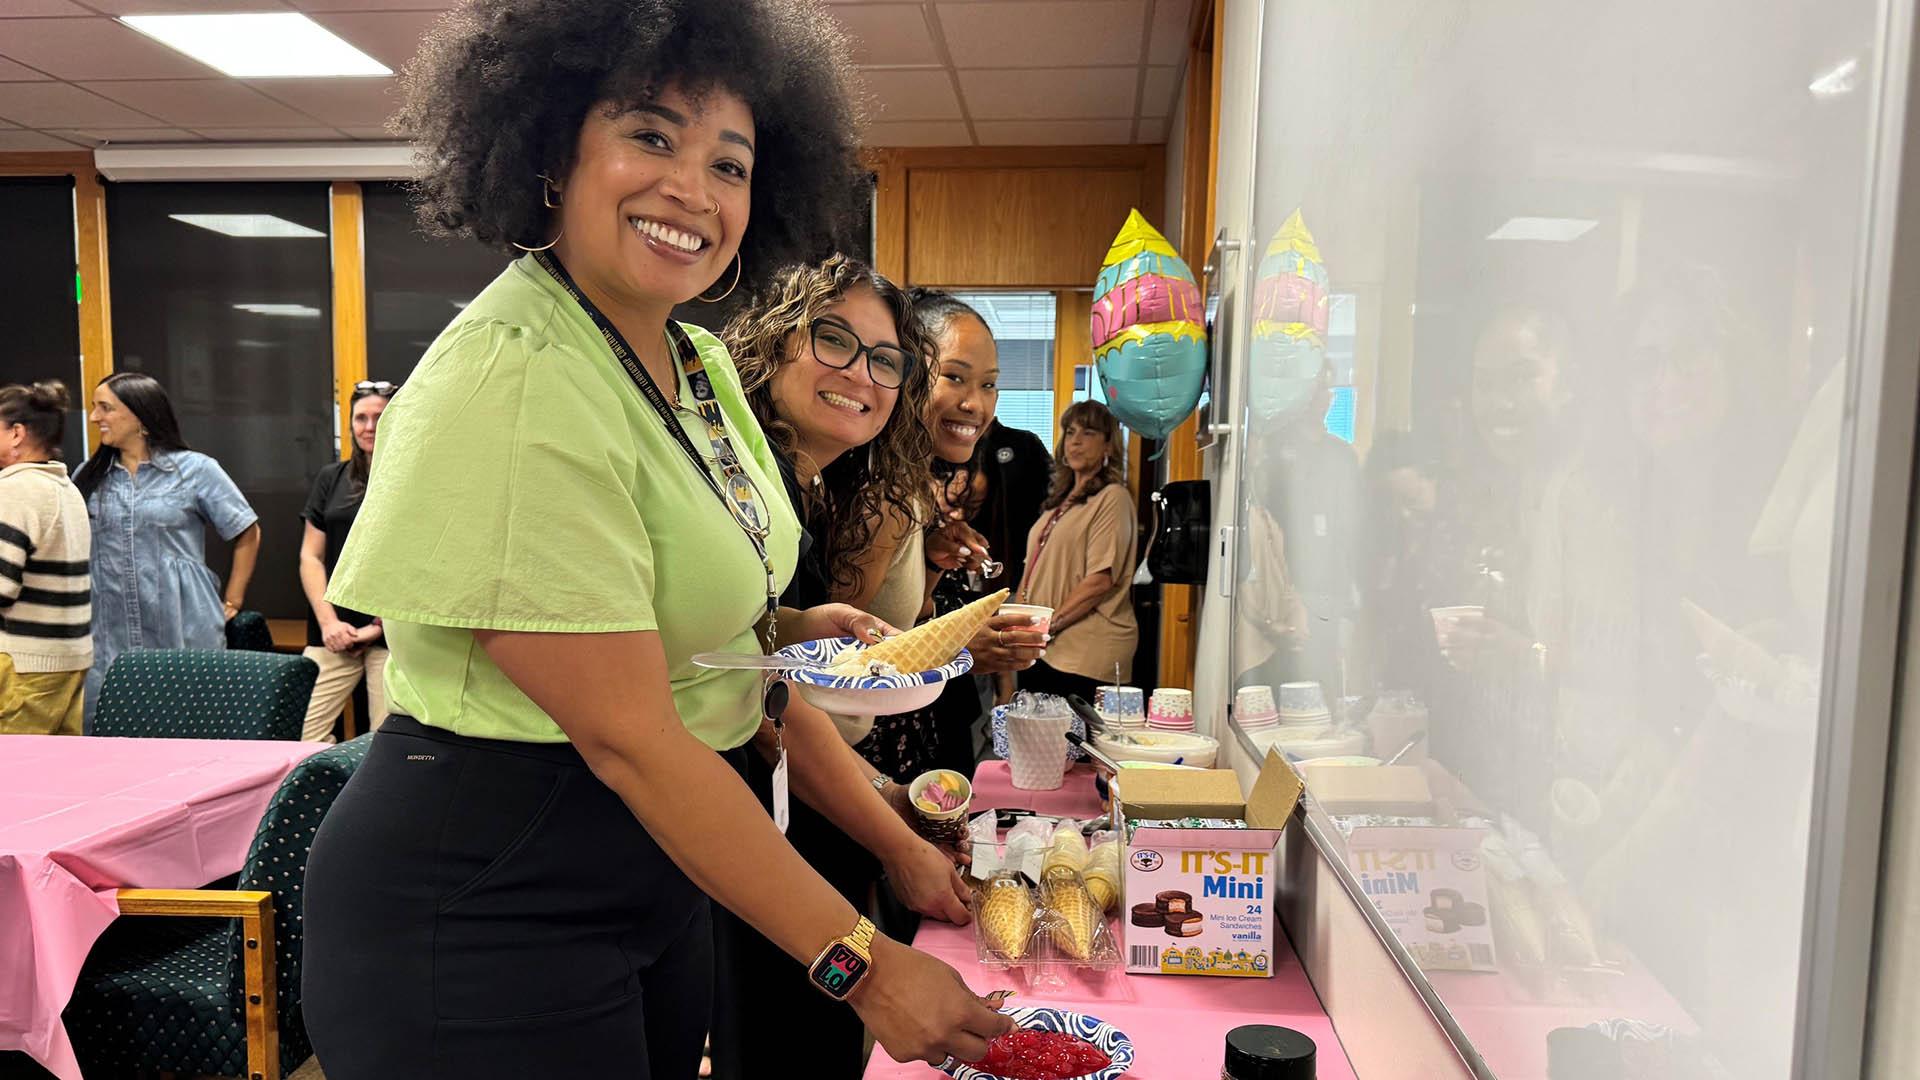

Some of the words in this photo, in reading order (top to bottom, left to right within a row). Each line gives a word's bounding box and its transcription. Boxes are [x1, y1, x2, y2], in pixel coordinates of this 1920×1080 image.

[1181, 850, 1269, 875] IT'S-IT
[1203, 875, 1263, 899] Mini
[1246, 904, 1262, 914] 24
[1220, 922, 1262, 930] Sandwiches
[1232, 931, 1262, 940] vanilla
